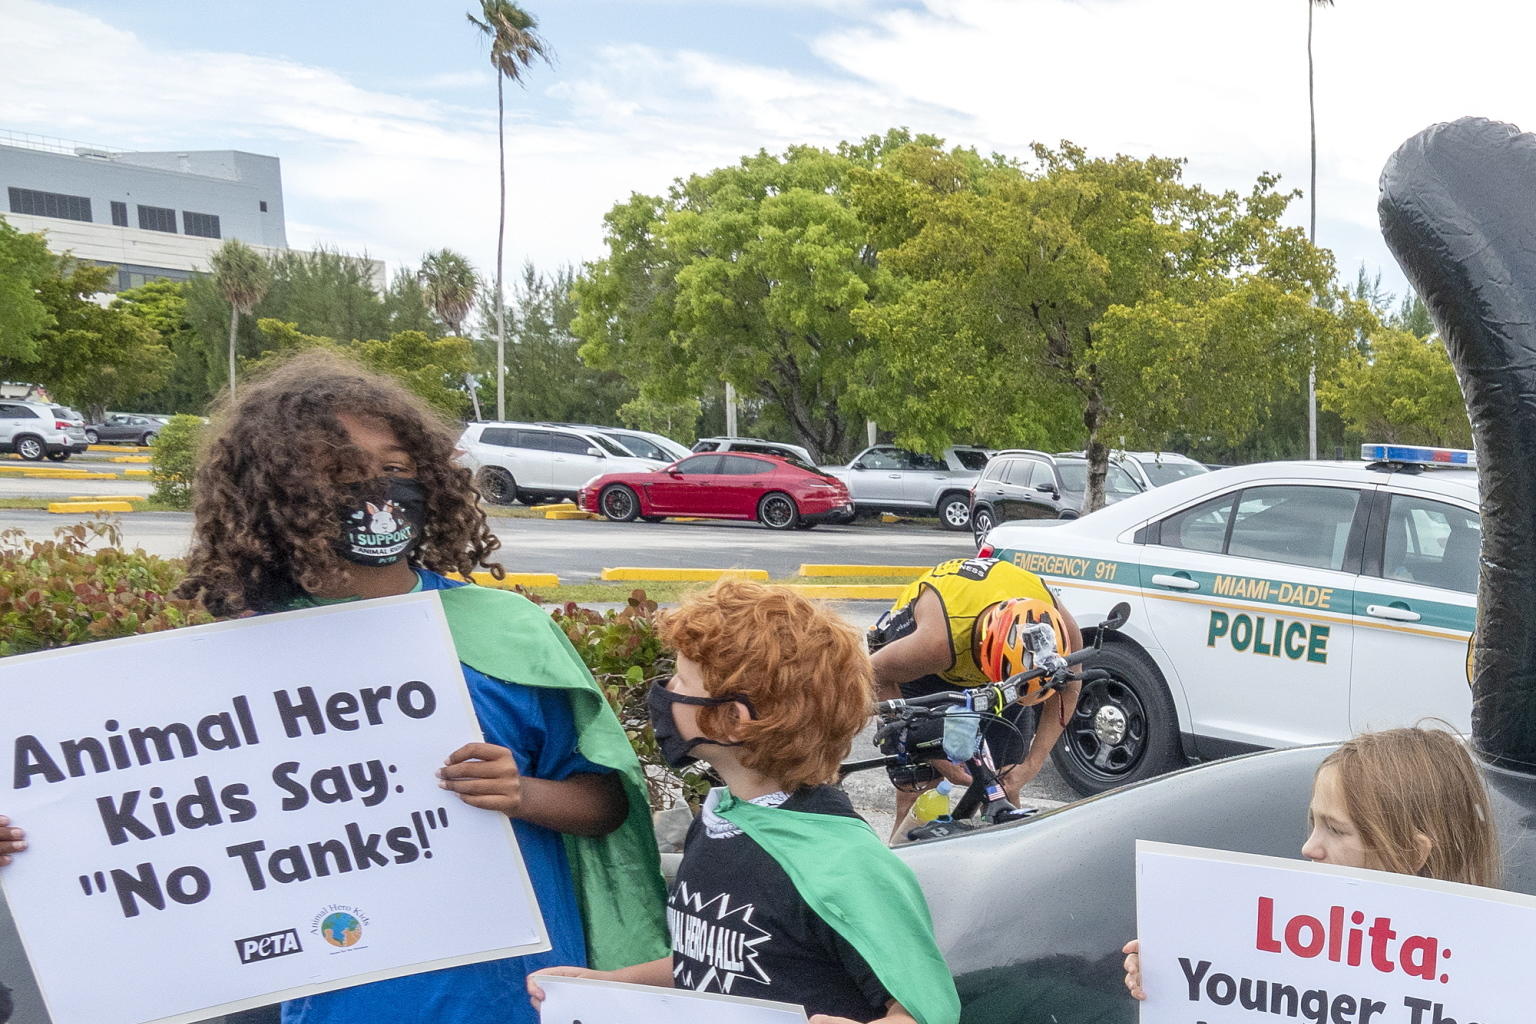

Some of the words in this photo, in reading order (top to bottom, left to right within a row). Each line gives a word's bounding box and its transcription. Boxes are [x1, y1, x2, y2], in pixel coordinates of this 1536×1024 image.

[357, 526, 411, 545] SUPPORT
[1013, 552, 1090, 577] EMERGENCY
[1095, 561, 1116, 581] 911
[1213, 575, 1334, 609] MIAMI-DADE
[1207, 609, 1331, 664] POLICE
[13, 695, 259, 790] Animal
[273, 680, 437, 738] Hero
[96, 776, 257, 846] Kids
[273, 759, 404, 812] Say:
[78, 861, 212, 918] "No
[226, 807, 449, 891] Tanks!"
[1256, 896, 1452, 983] Lolita:
